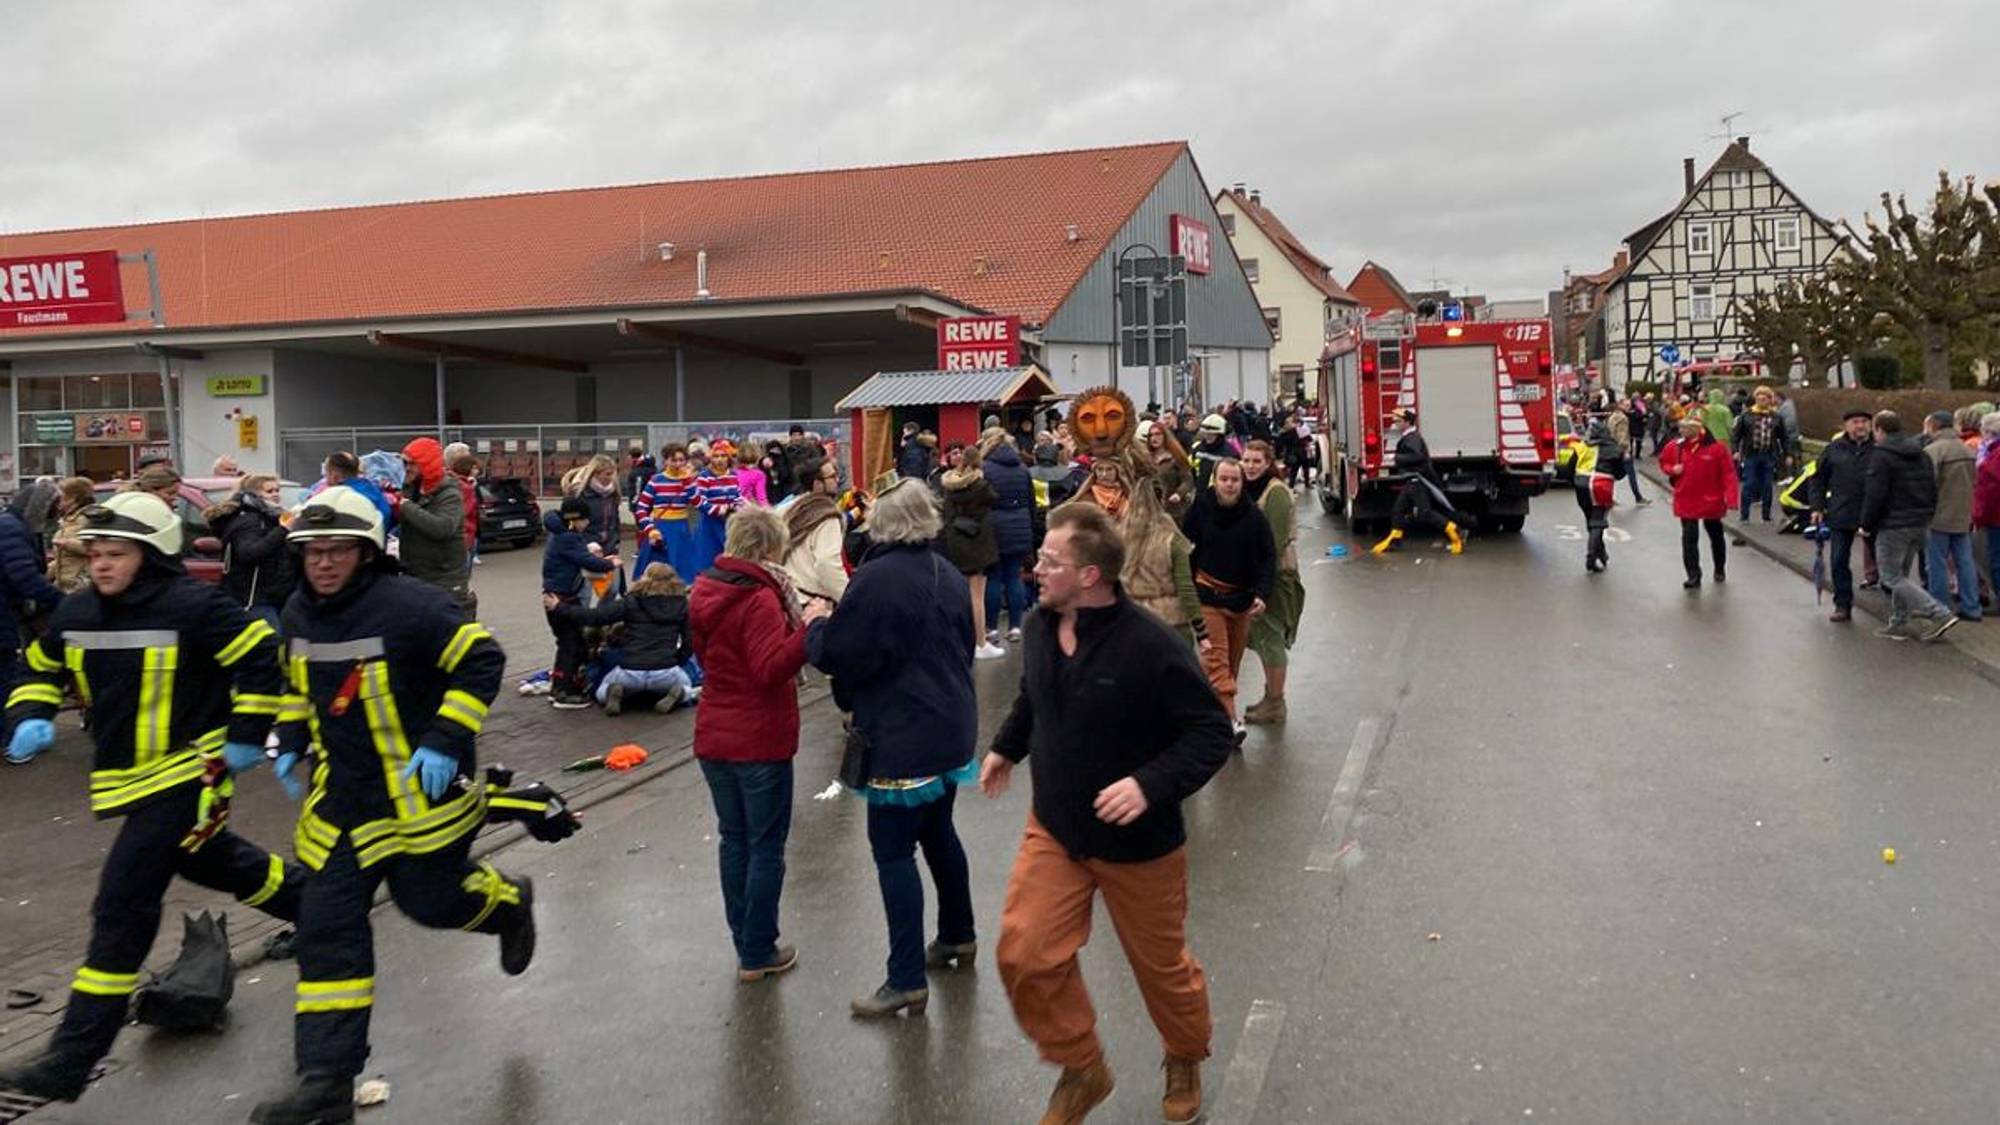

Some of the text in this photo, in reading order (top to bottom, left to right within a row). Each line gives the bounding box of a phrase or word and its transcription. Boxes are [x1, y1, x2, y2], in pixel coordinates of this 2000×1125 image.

[1179, 224, 1210, 267] REWE
[945, 321, 1008, 342] REWE
[1516, 324, 1542, 341] 112
[946, 350, 1009, 372] REWE
